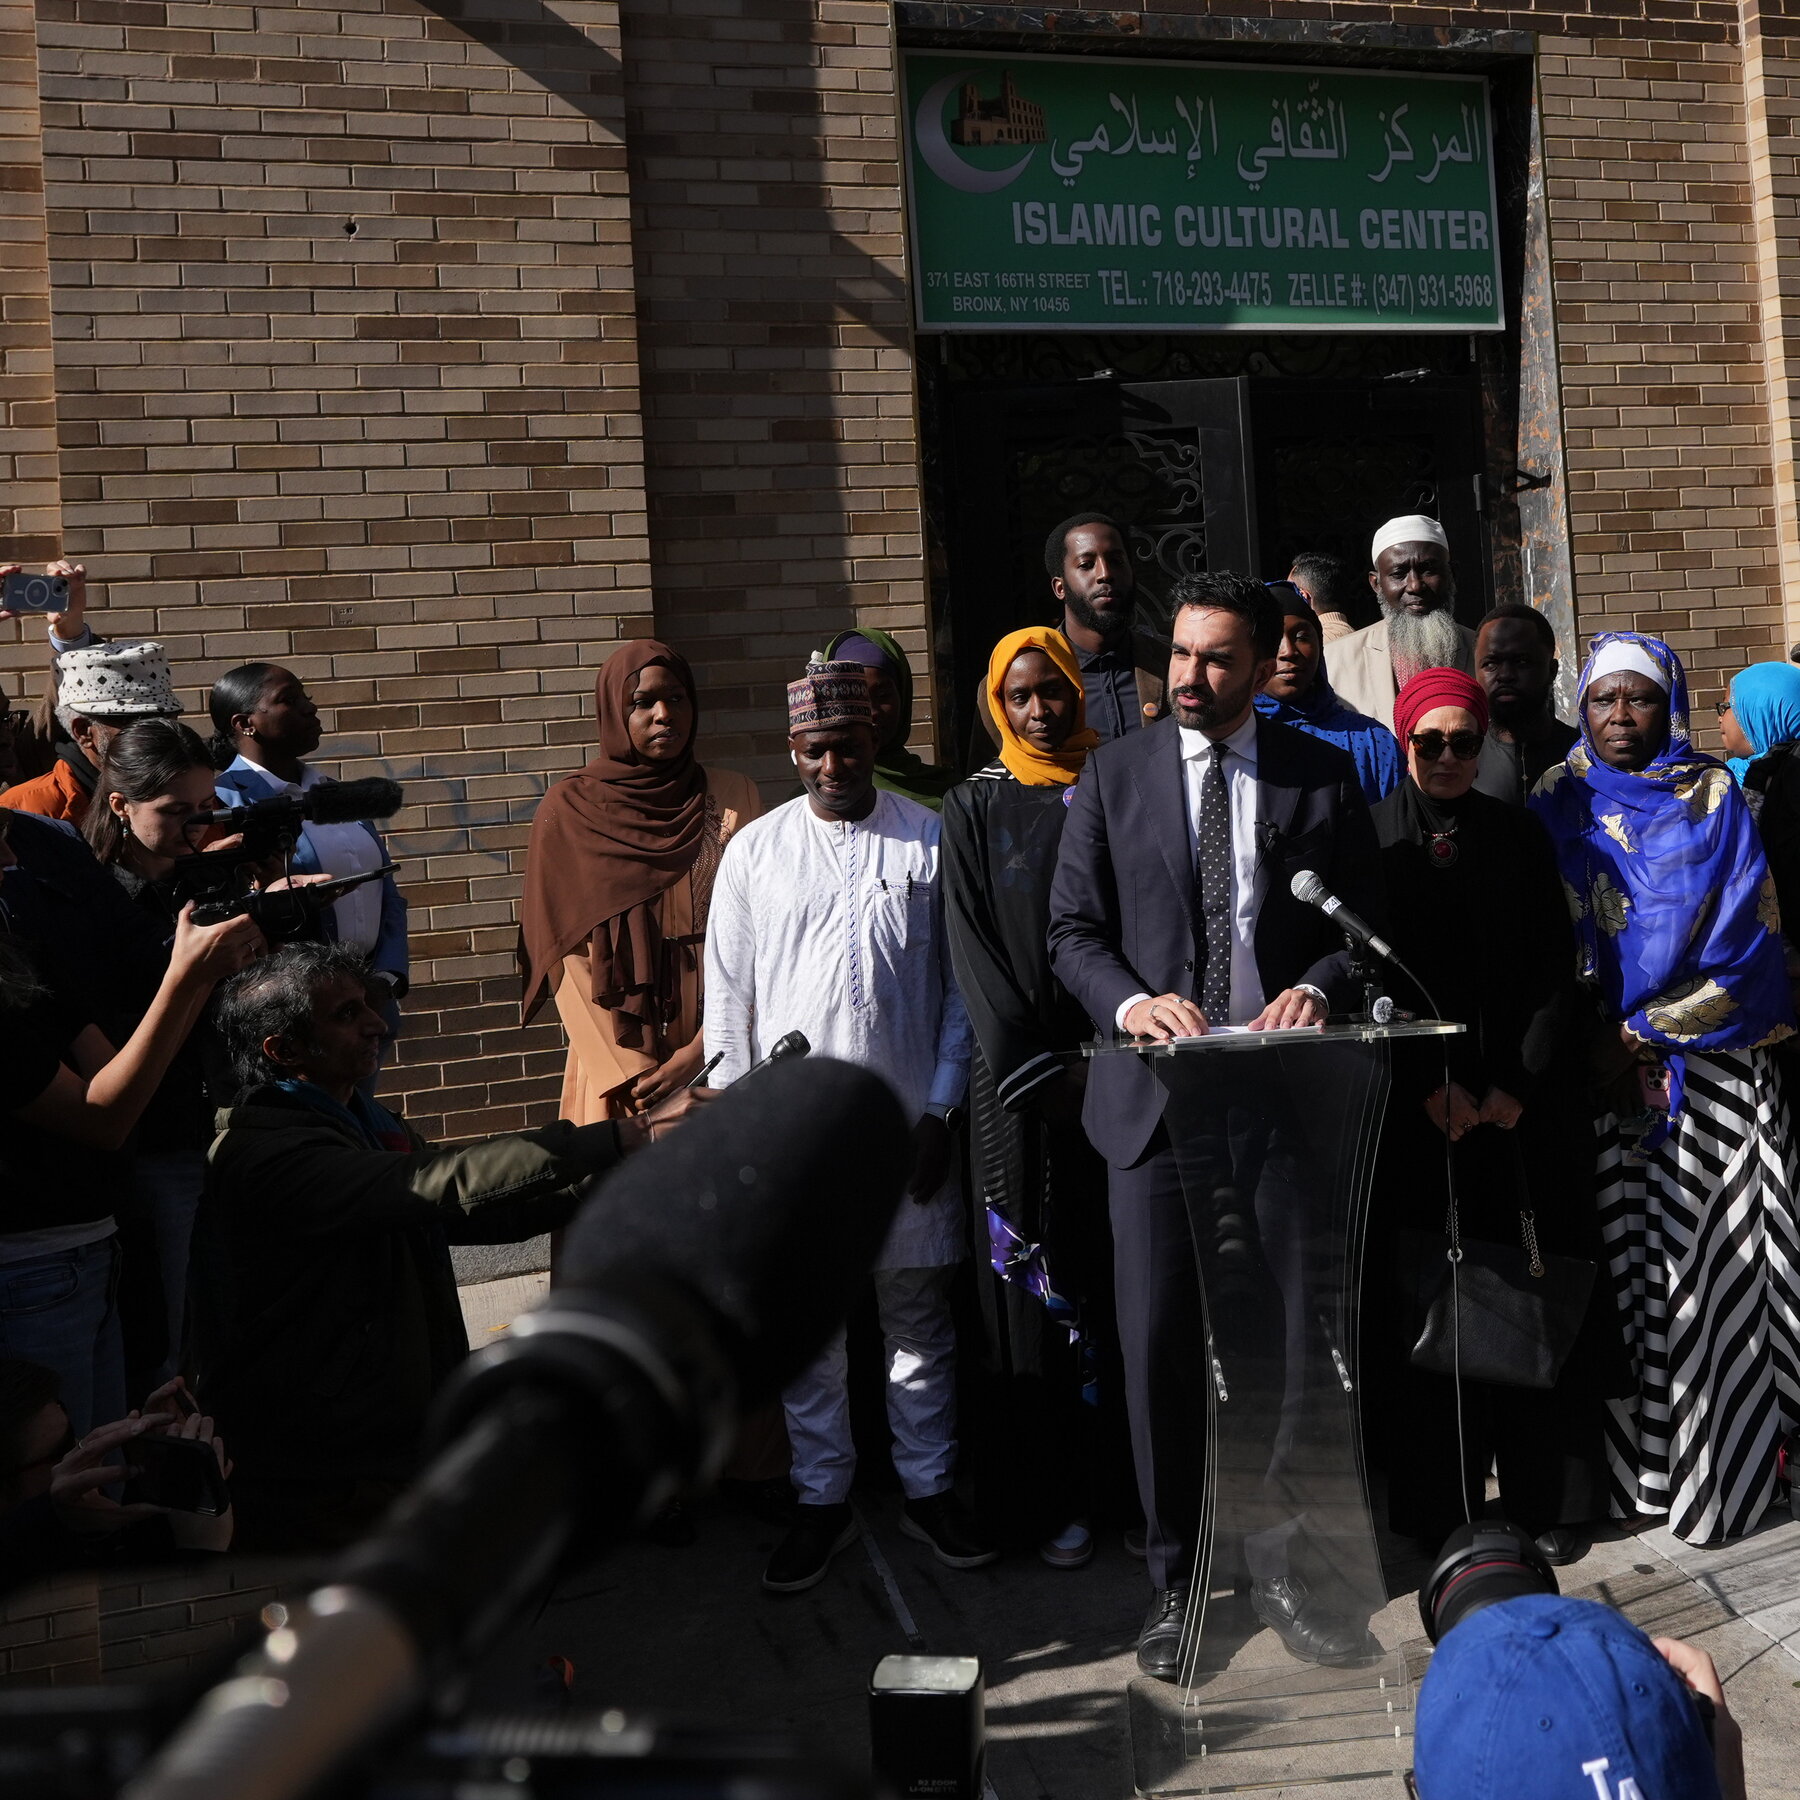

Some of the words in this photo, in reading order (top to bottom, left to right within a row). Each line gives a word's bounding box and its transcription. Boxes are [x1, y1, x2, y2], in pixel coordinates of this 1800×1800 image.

[1050, 92, 1218, 187] الإسلامي
[1367, 103, 1481, 184] المركز
[1011, 201, 1162, 247] ISLAMIC
[1174, 205, 1349, 249] CULTURAL
[1359, 208, 1489, 250] CENTER
[927, 272, 949, 288] 371
[954, 272, 991, 288] EAST
[994, 272, 1035, 289] 166TH
[1038, 273, 1091, 289] STREET
[1152, 271, 1272, 307] 718-293-4475
[1287, 273, 1348, 306] ZELLE
[1350, 273, 1368, 307] #:
[1372, 273, 1414, 316] (347)
[1418, 274, 1493, 308] 931-5968
[953, 296, 1007, 314] BRONX,
[1010, 296, 1028, 312] NY
[1032, 296, 1070, 312] 10456
